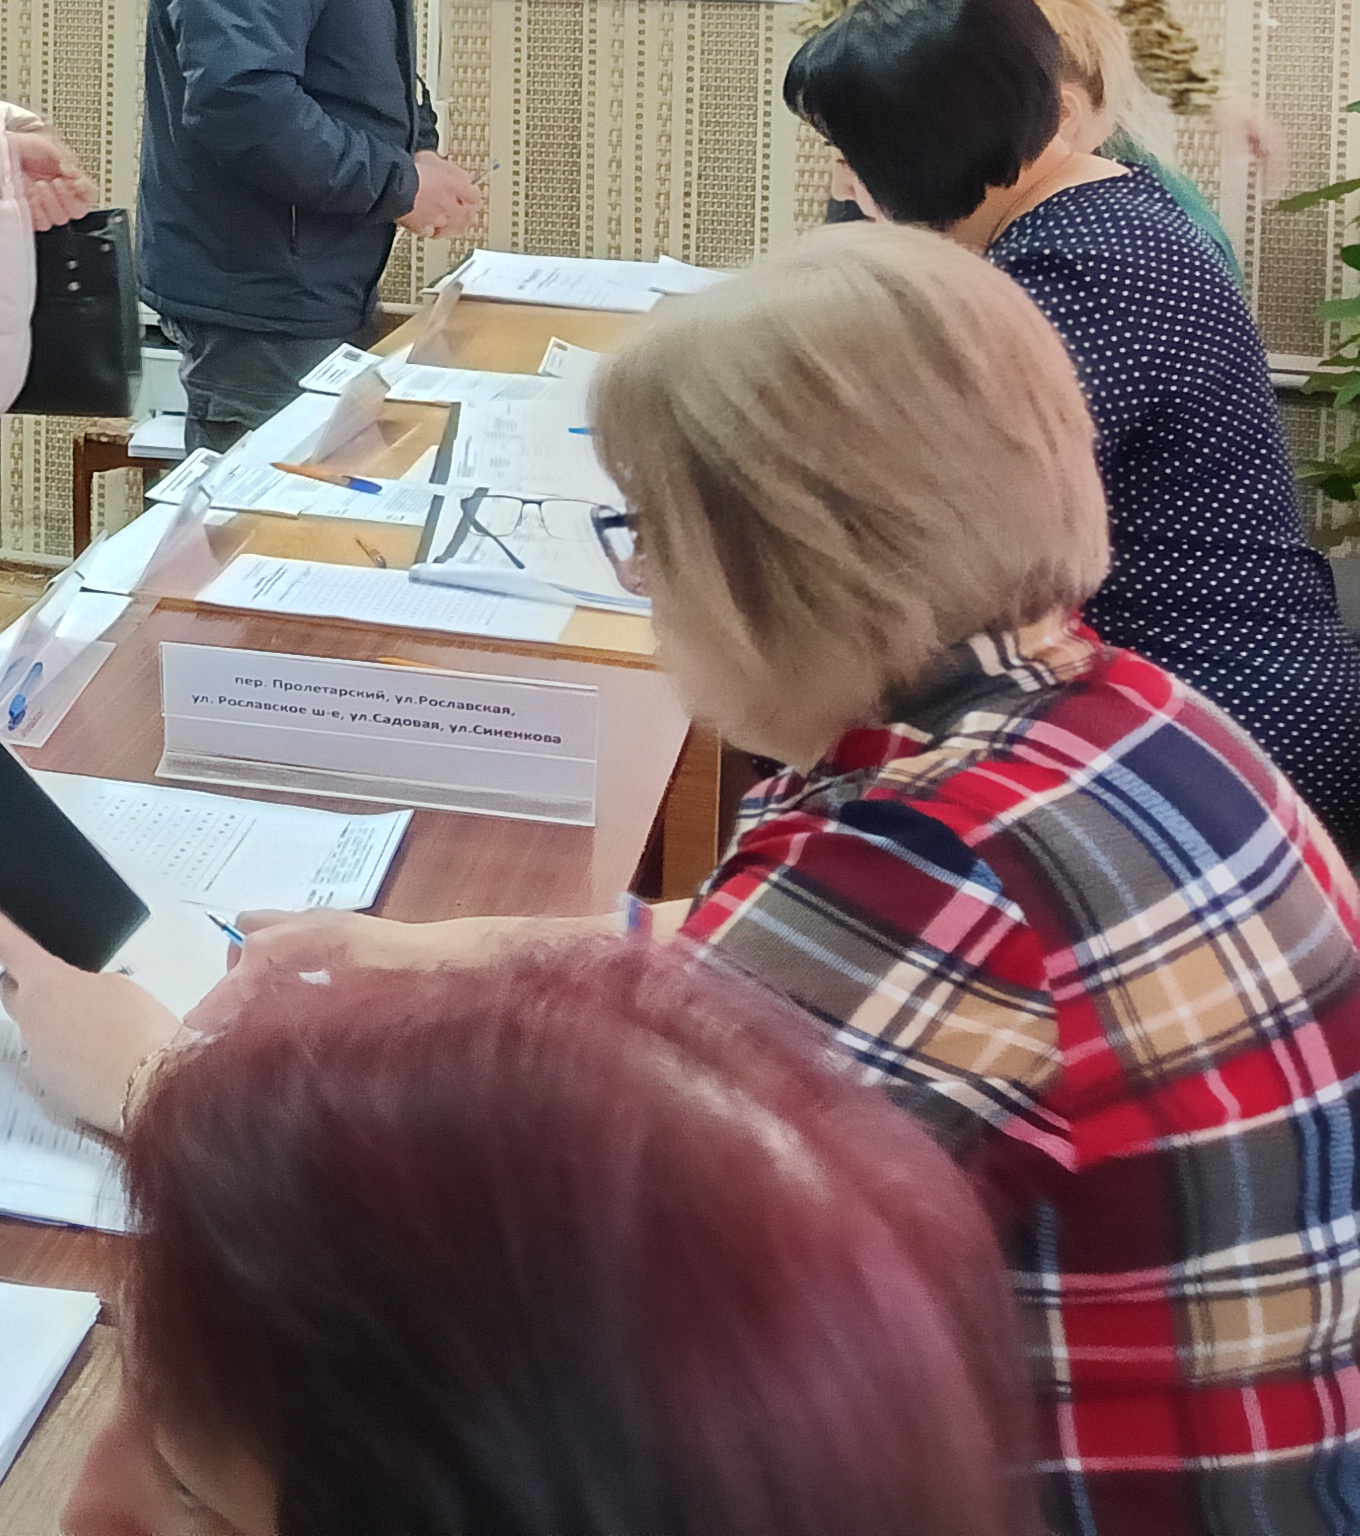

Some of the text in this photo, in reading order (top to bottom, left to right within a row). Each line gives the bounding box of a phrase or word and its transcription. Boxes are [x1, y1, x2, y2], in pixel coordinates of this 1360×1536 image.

[191, 693, 563, 745] ул. Рославское ш-е, ул.Садовая, ул.Синенкова
[234, 675, 517, 717] пер. Пролетарский, ул.Рославская,
